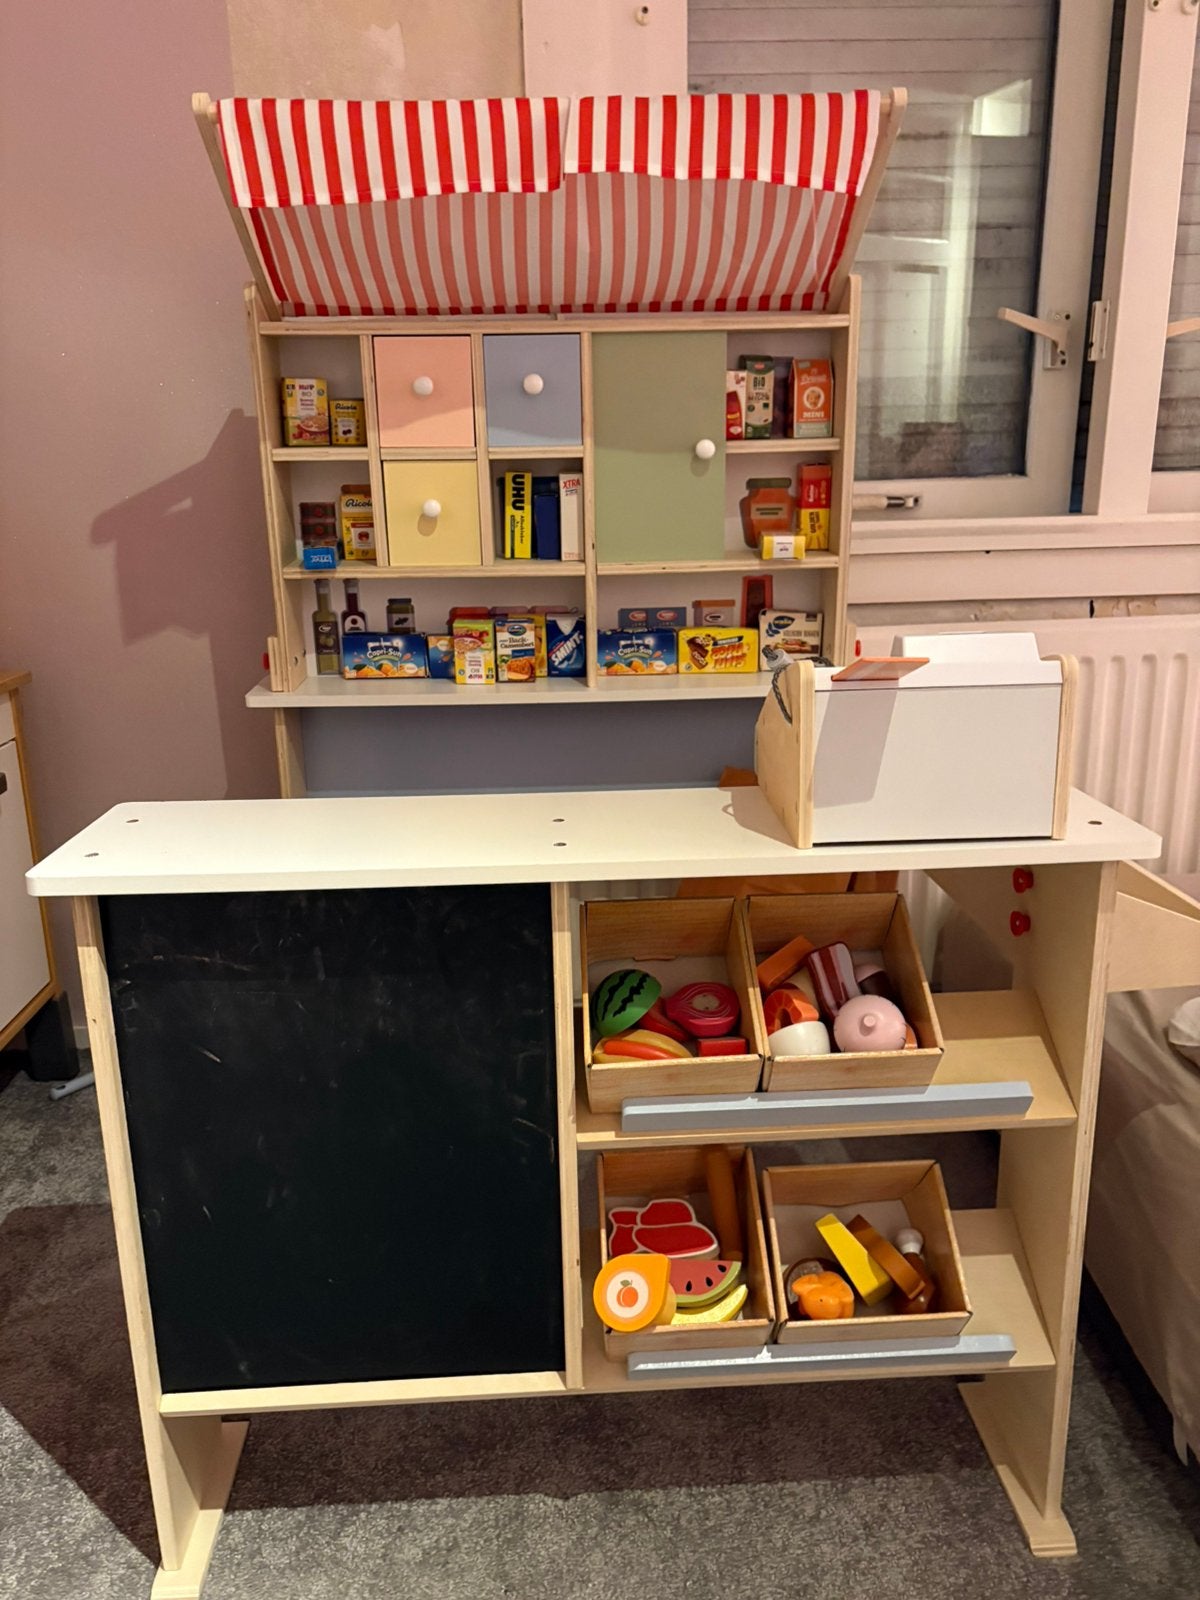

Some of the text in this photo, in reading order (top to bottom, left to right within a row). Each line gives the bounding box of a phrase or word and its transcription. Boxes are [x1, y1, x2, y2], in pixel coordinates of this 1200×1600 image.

[335, 403, 358, 411] Ricola
[511, 474, 525, 511] UHU
[367, 647, 402, 659] Capri-Sun
[551, 631, 581, 666] SMINT
